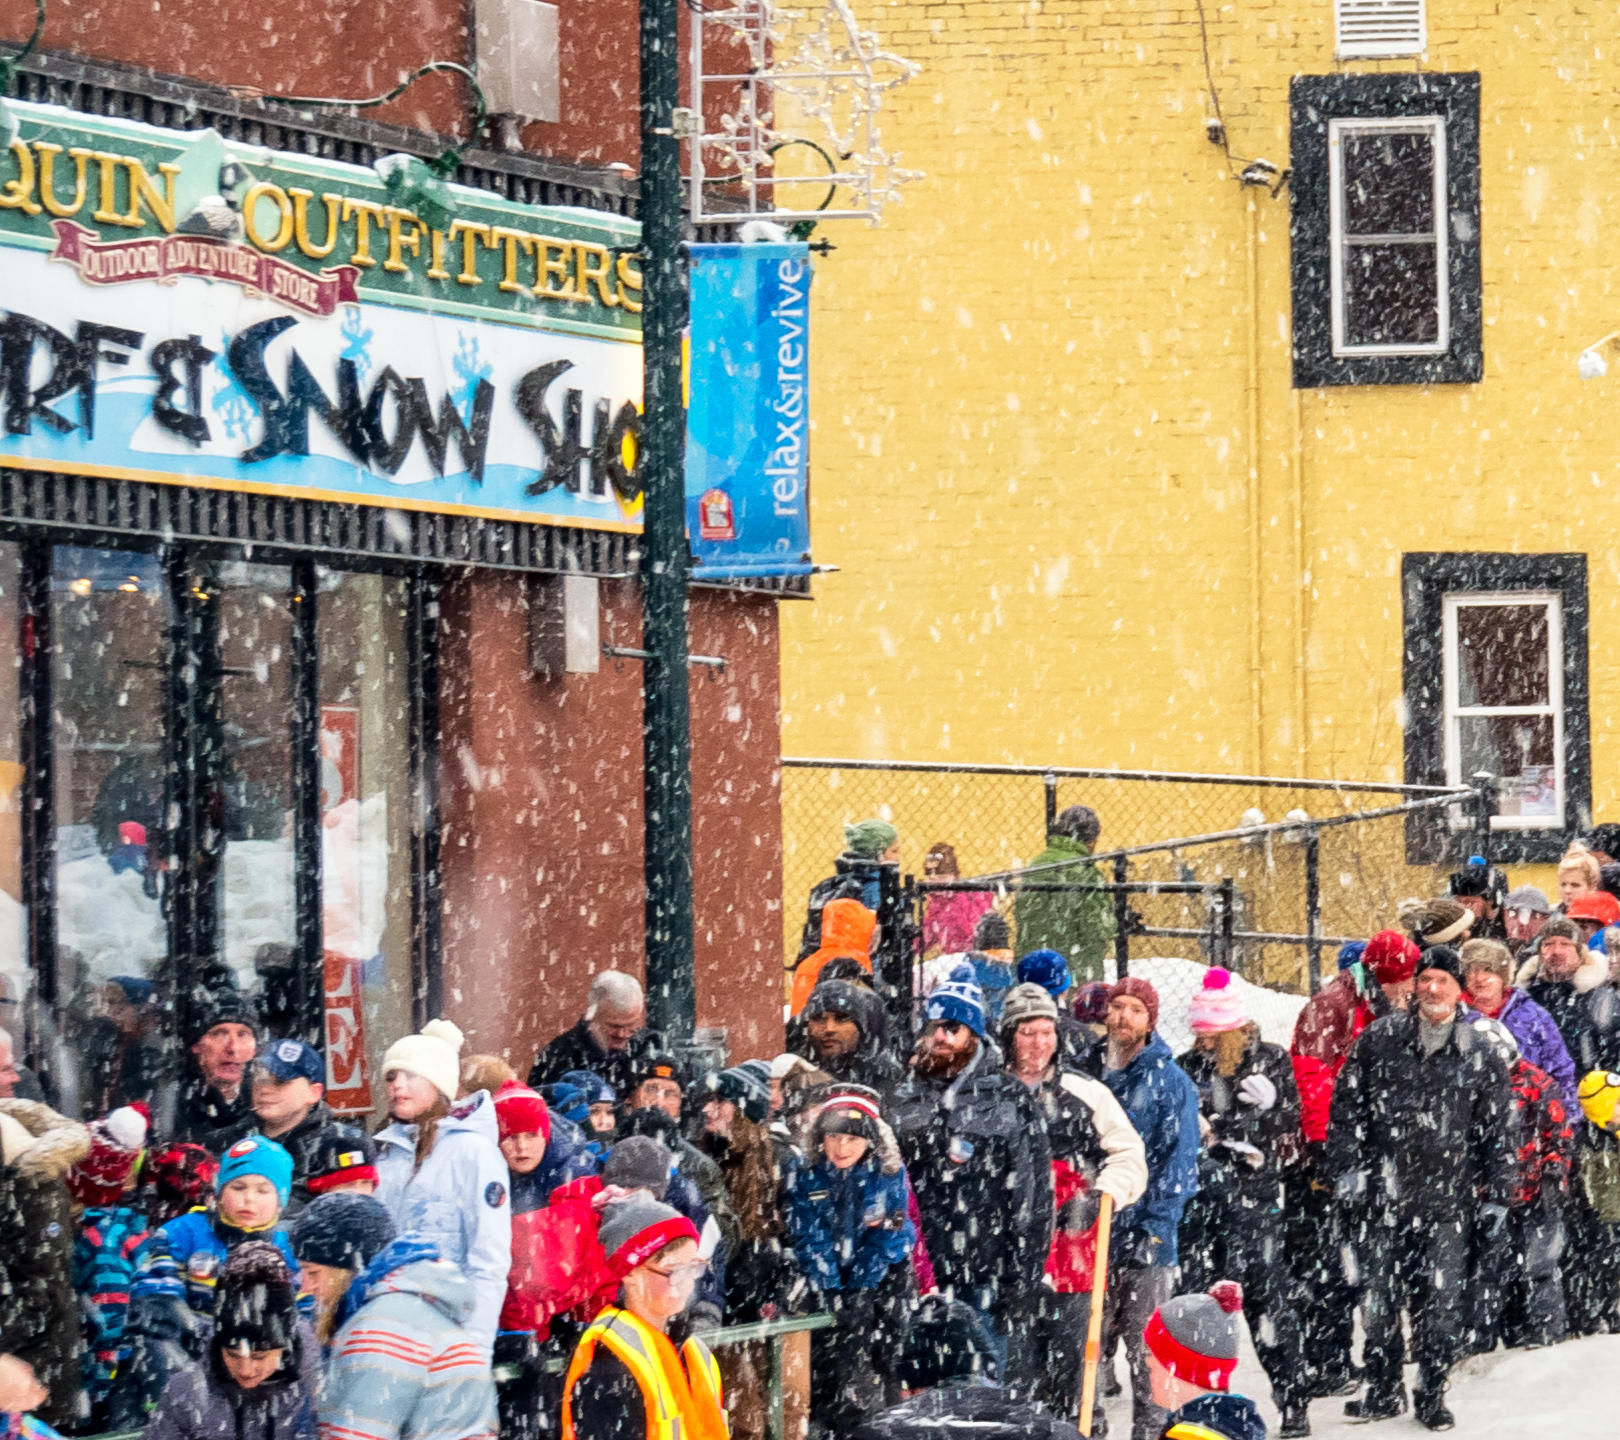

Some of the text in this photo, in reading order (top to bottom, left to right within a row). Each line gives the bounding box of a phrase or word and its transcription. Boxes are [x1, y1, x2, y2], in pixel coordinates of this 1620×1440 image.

[82, 241, 320, 310] OUTDOOR ADVENTURE STORE
[242, 181, 643, 313] OUTFITTERS
[229, 314, 496, 488] SNOW
[765, 258, 806, 518] relax&revive
